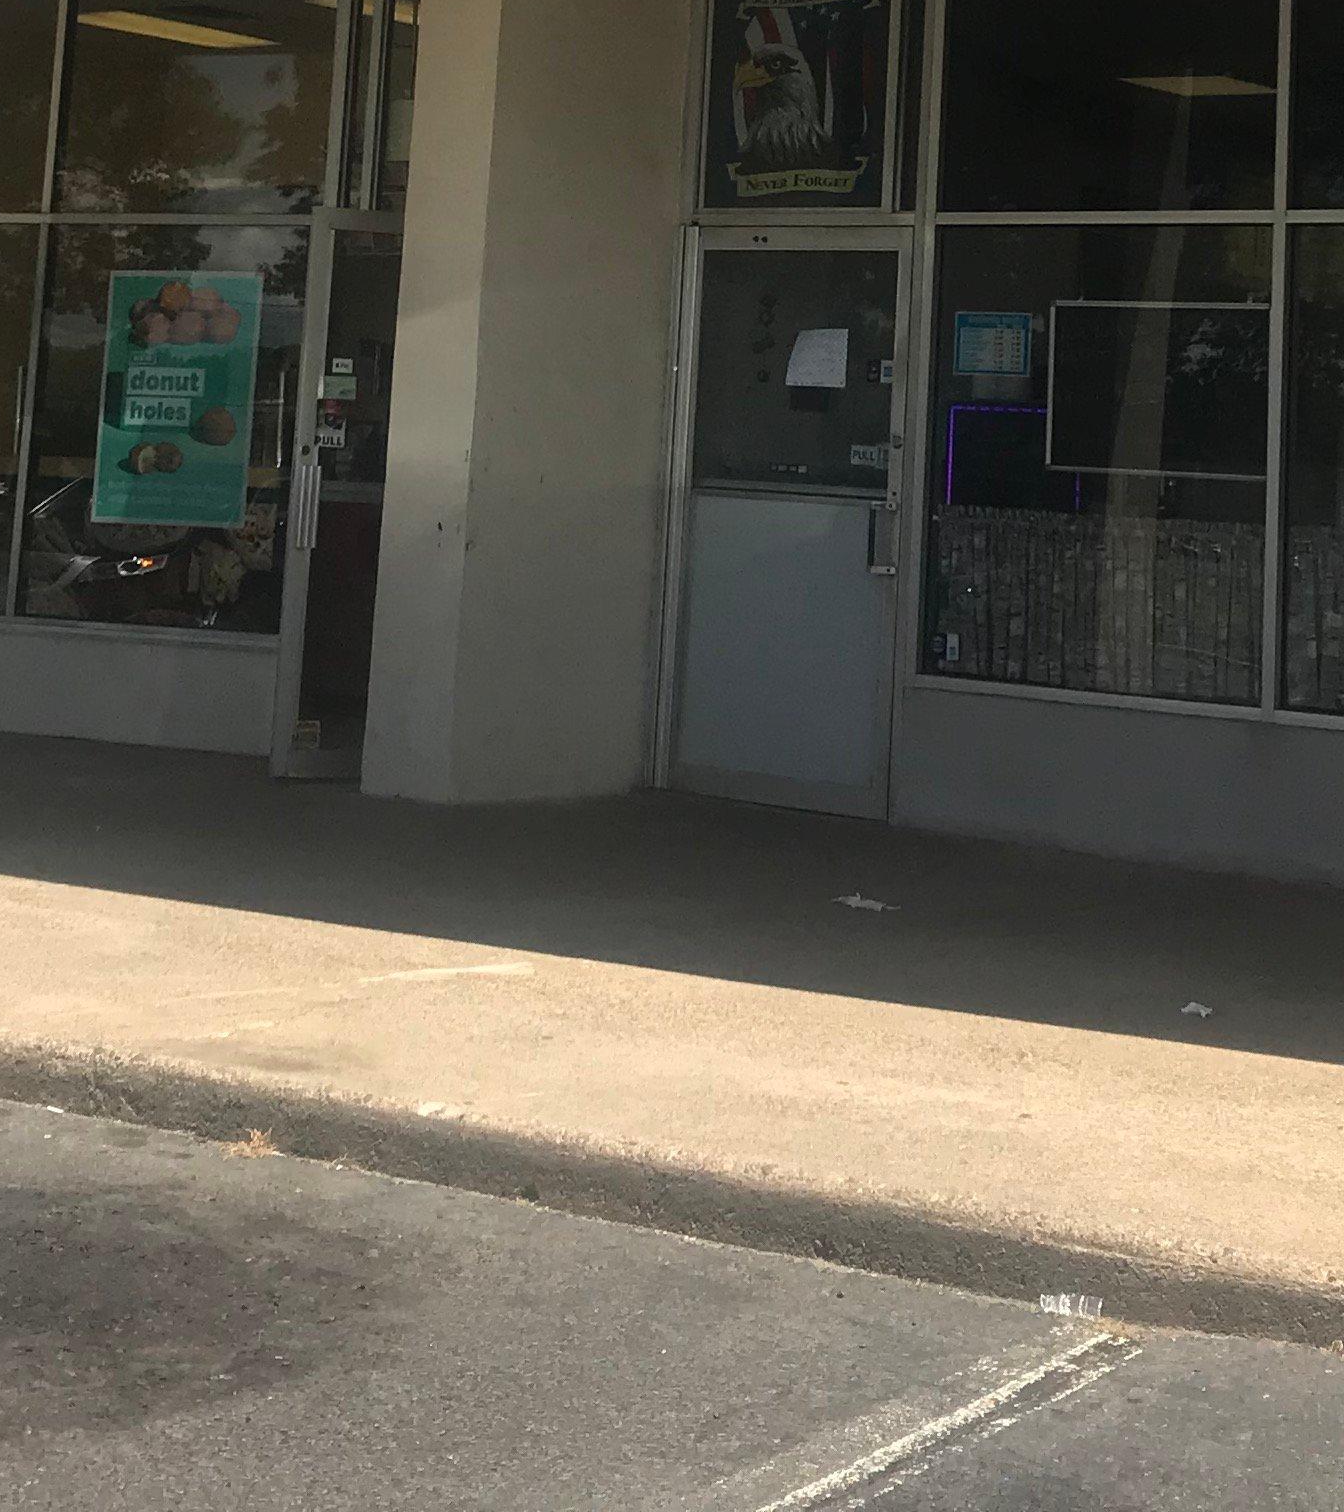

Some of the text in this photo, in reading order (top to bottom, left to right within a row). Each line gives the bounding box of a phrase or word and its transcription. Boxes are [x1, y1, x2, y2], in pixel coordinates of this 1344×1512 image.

[130, 370, 201, 392] donut
[130, 401, 187, 421] holes
[314, 435, 343, 447] PULL
